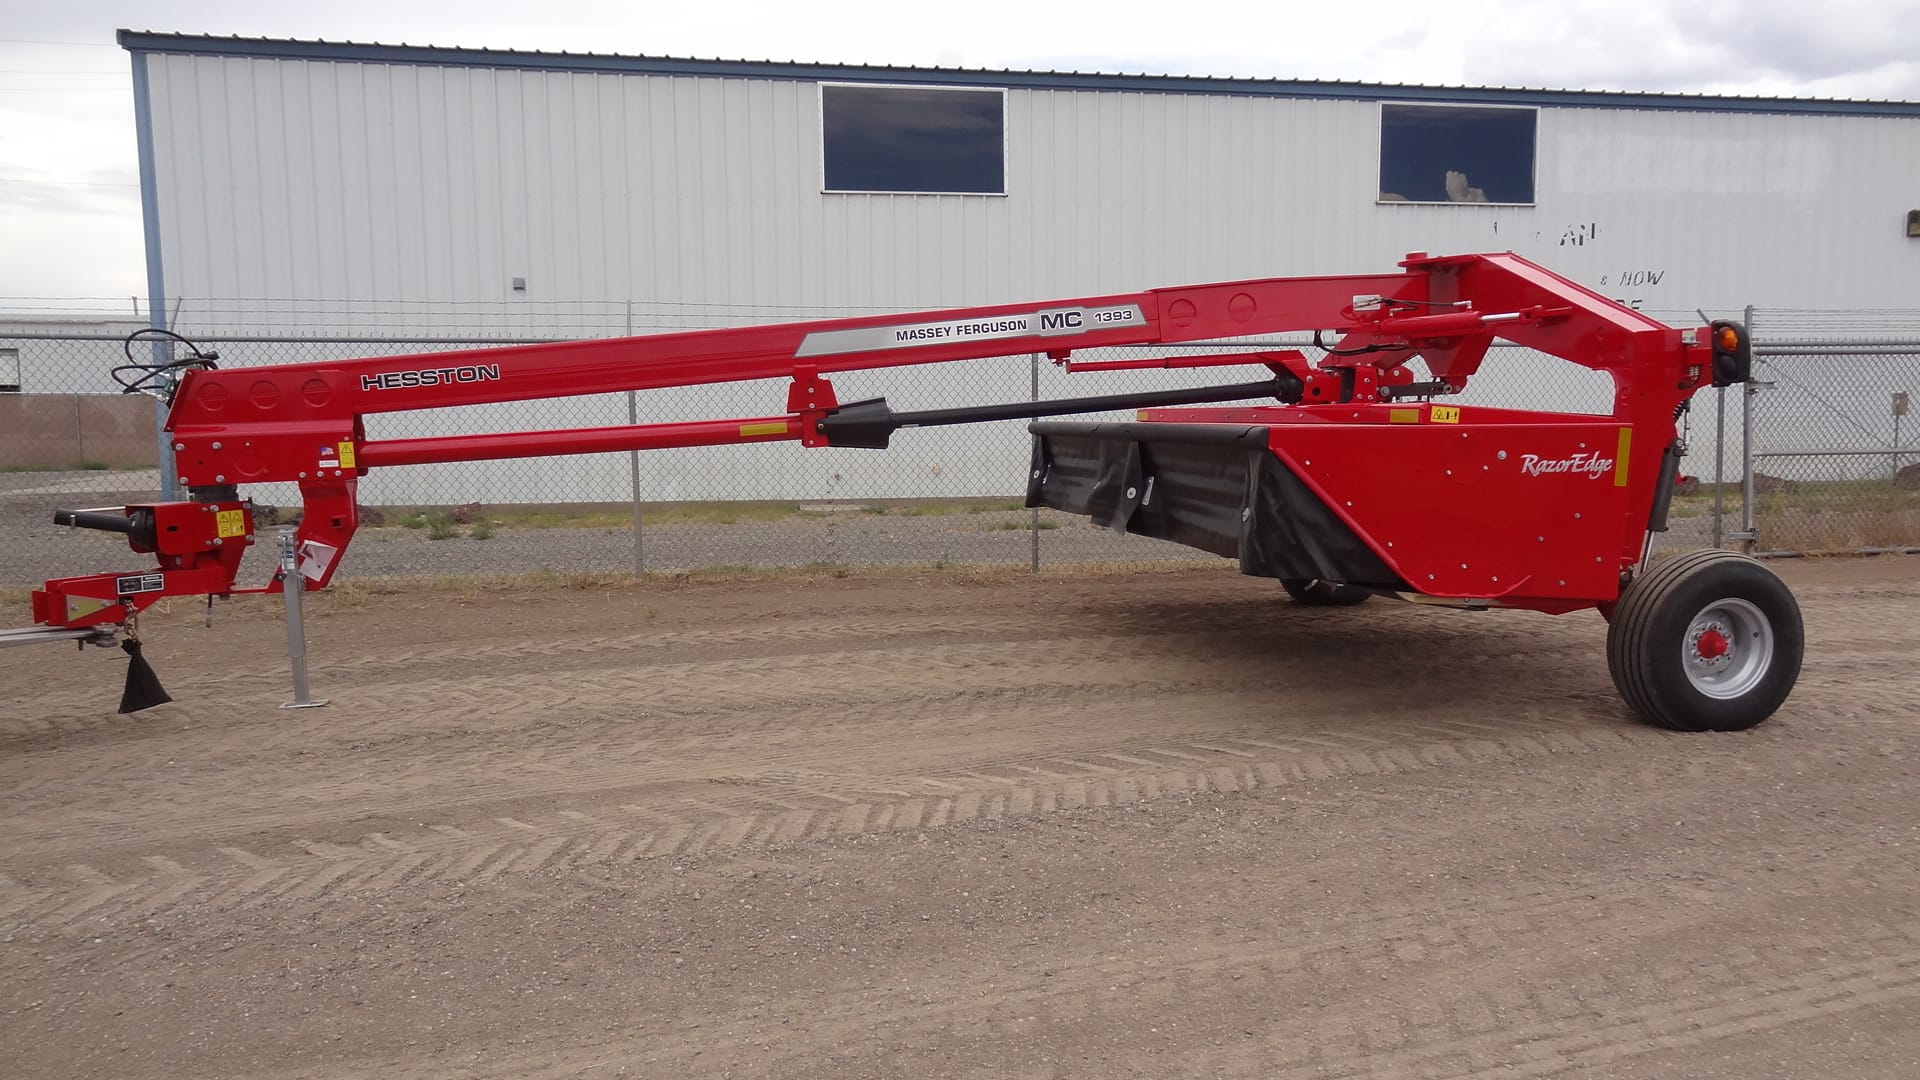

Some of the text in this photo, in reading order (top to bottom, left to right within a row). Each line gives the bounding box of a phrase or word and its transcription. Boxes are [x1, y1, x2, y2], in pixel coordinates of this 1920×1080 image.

[896, 310, 1133, 341] MASSEY FERGUSON MC 1393
[361, 364, 500, 391] HESSTON
[1520, 450, 1613, 480] RazorEdge
